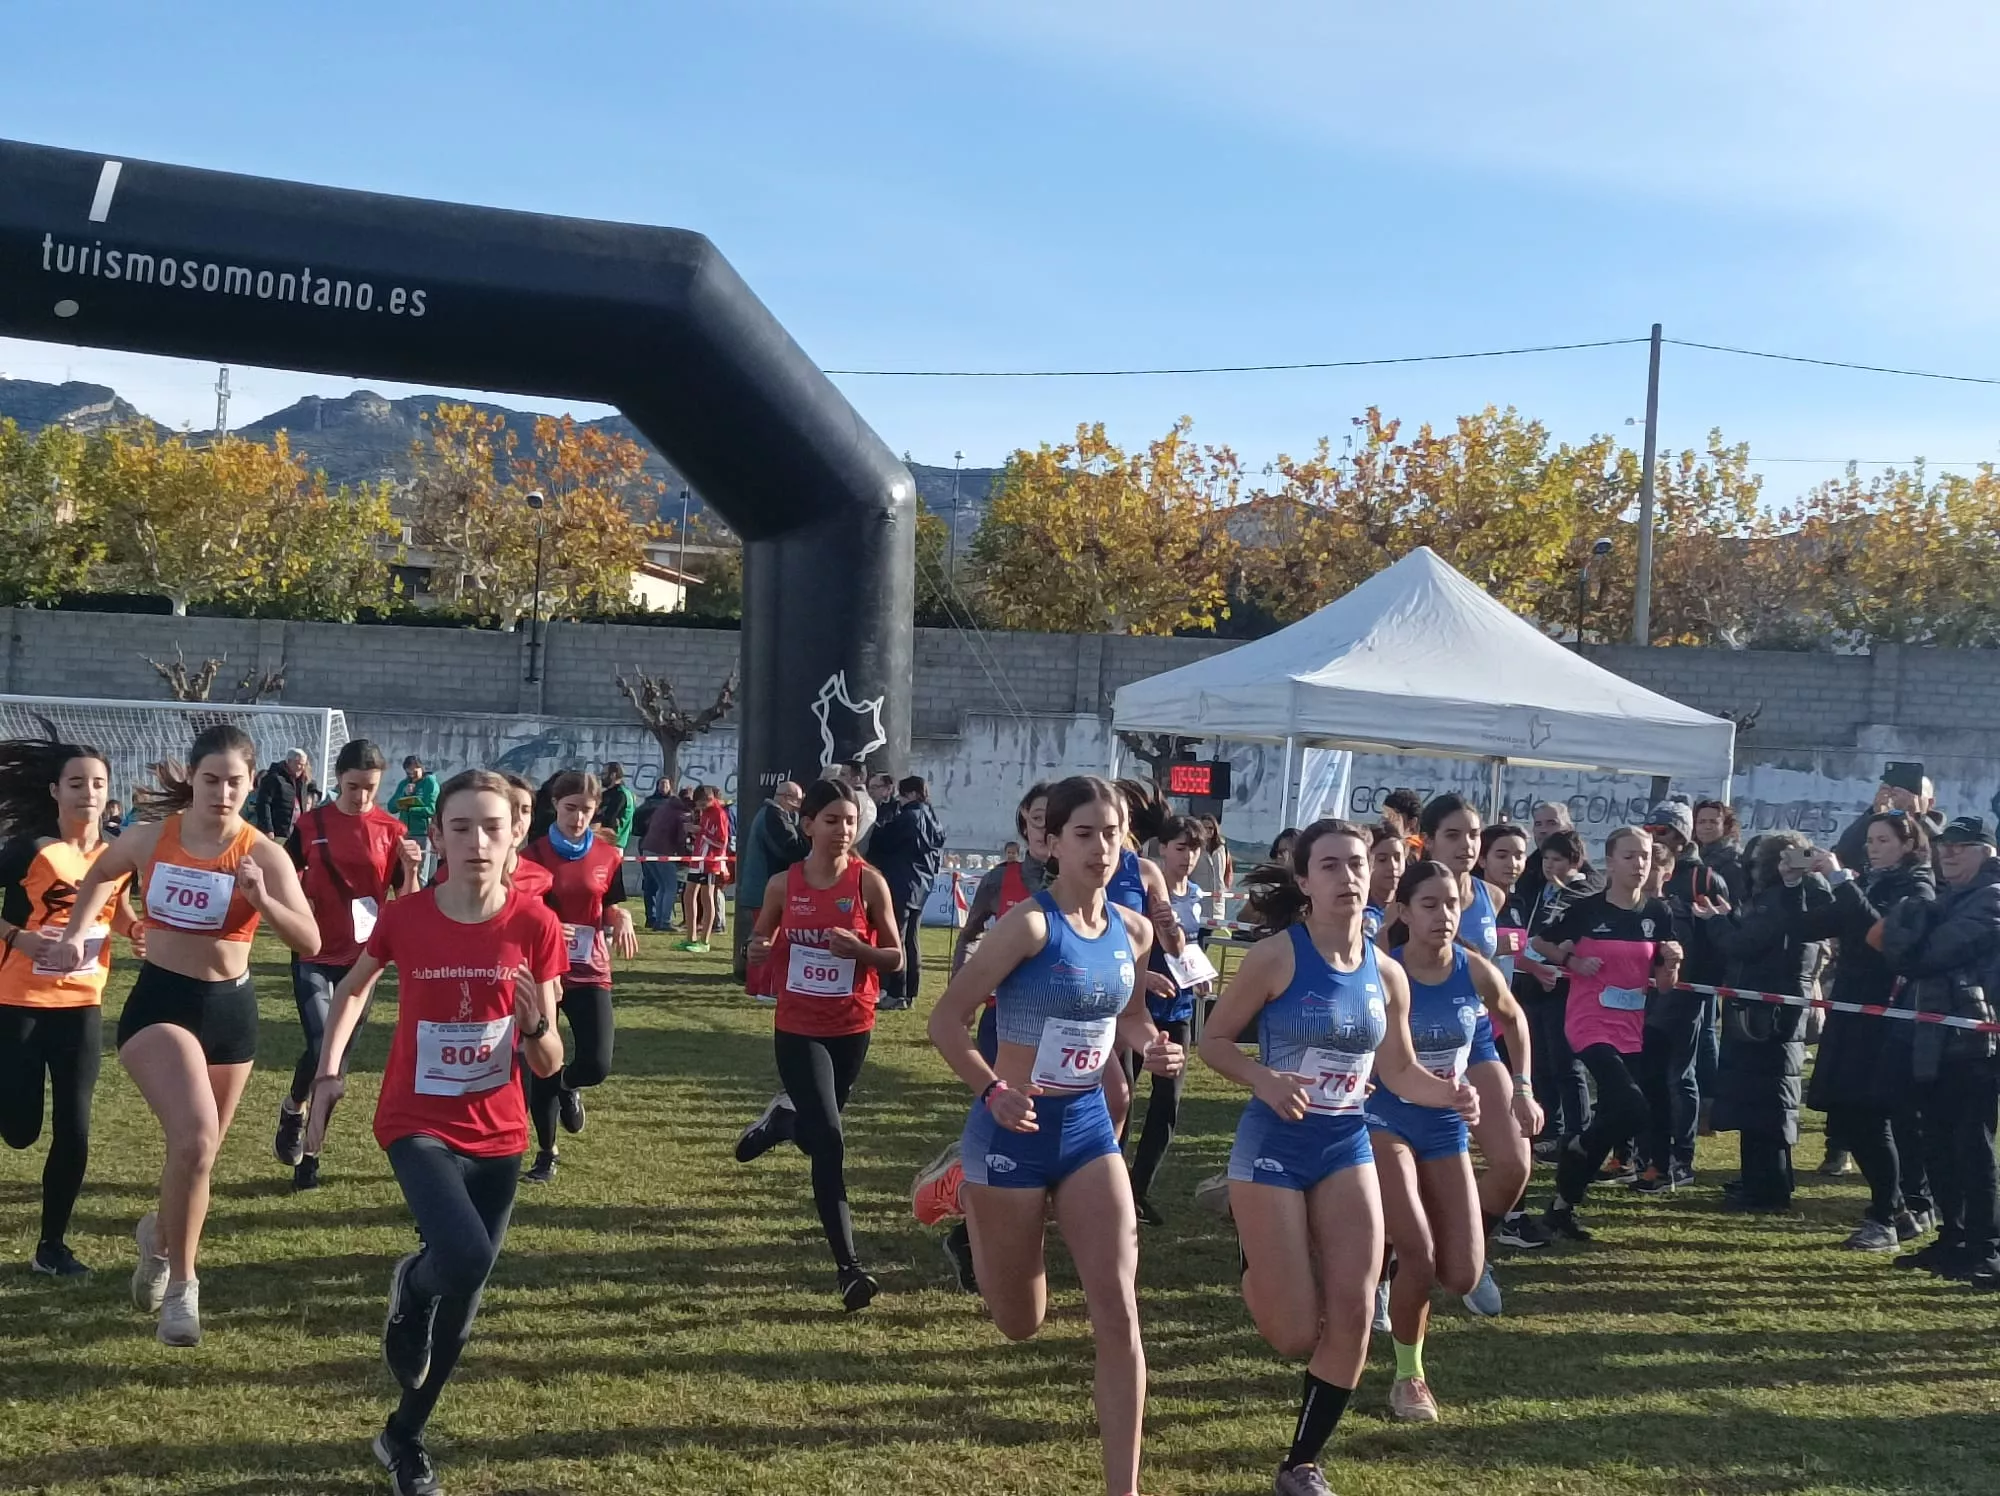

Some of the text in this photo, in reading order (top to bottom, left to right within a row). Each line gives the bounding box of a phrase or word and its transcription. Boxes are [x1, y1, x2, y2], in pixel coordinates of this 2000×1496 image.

[42, 232, 428, 317] turismosomontano.es
[165, 884, 210, 910] 708
[803, 965, 841, 982] 690
[441, 1044, 492, 1066] 808
[1060, 1047, 1102, 1070] 763
[1319, 1071, 1358, 1093] 778
